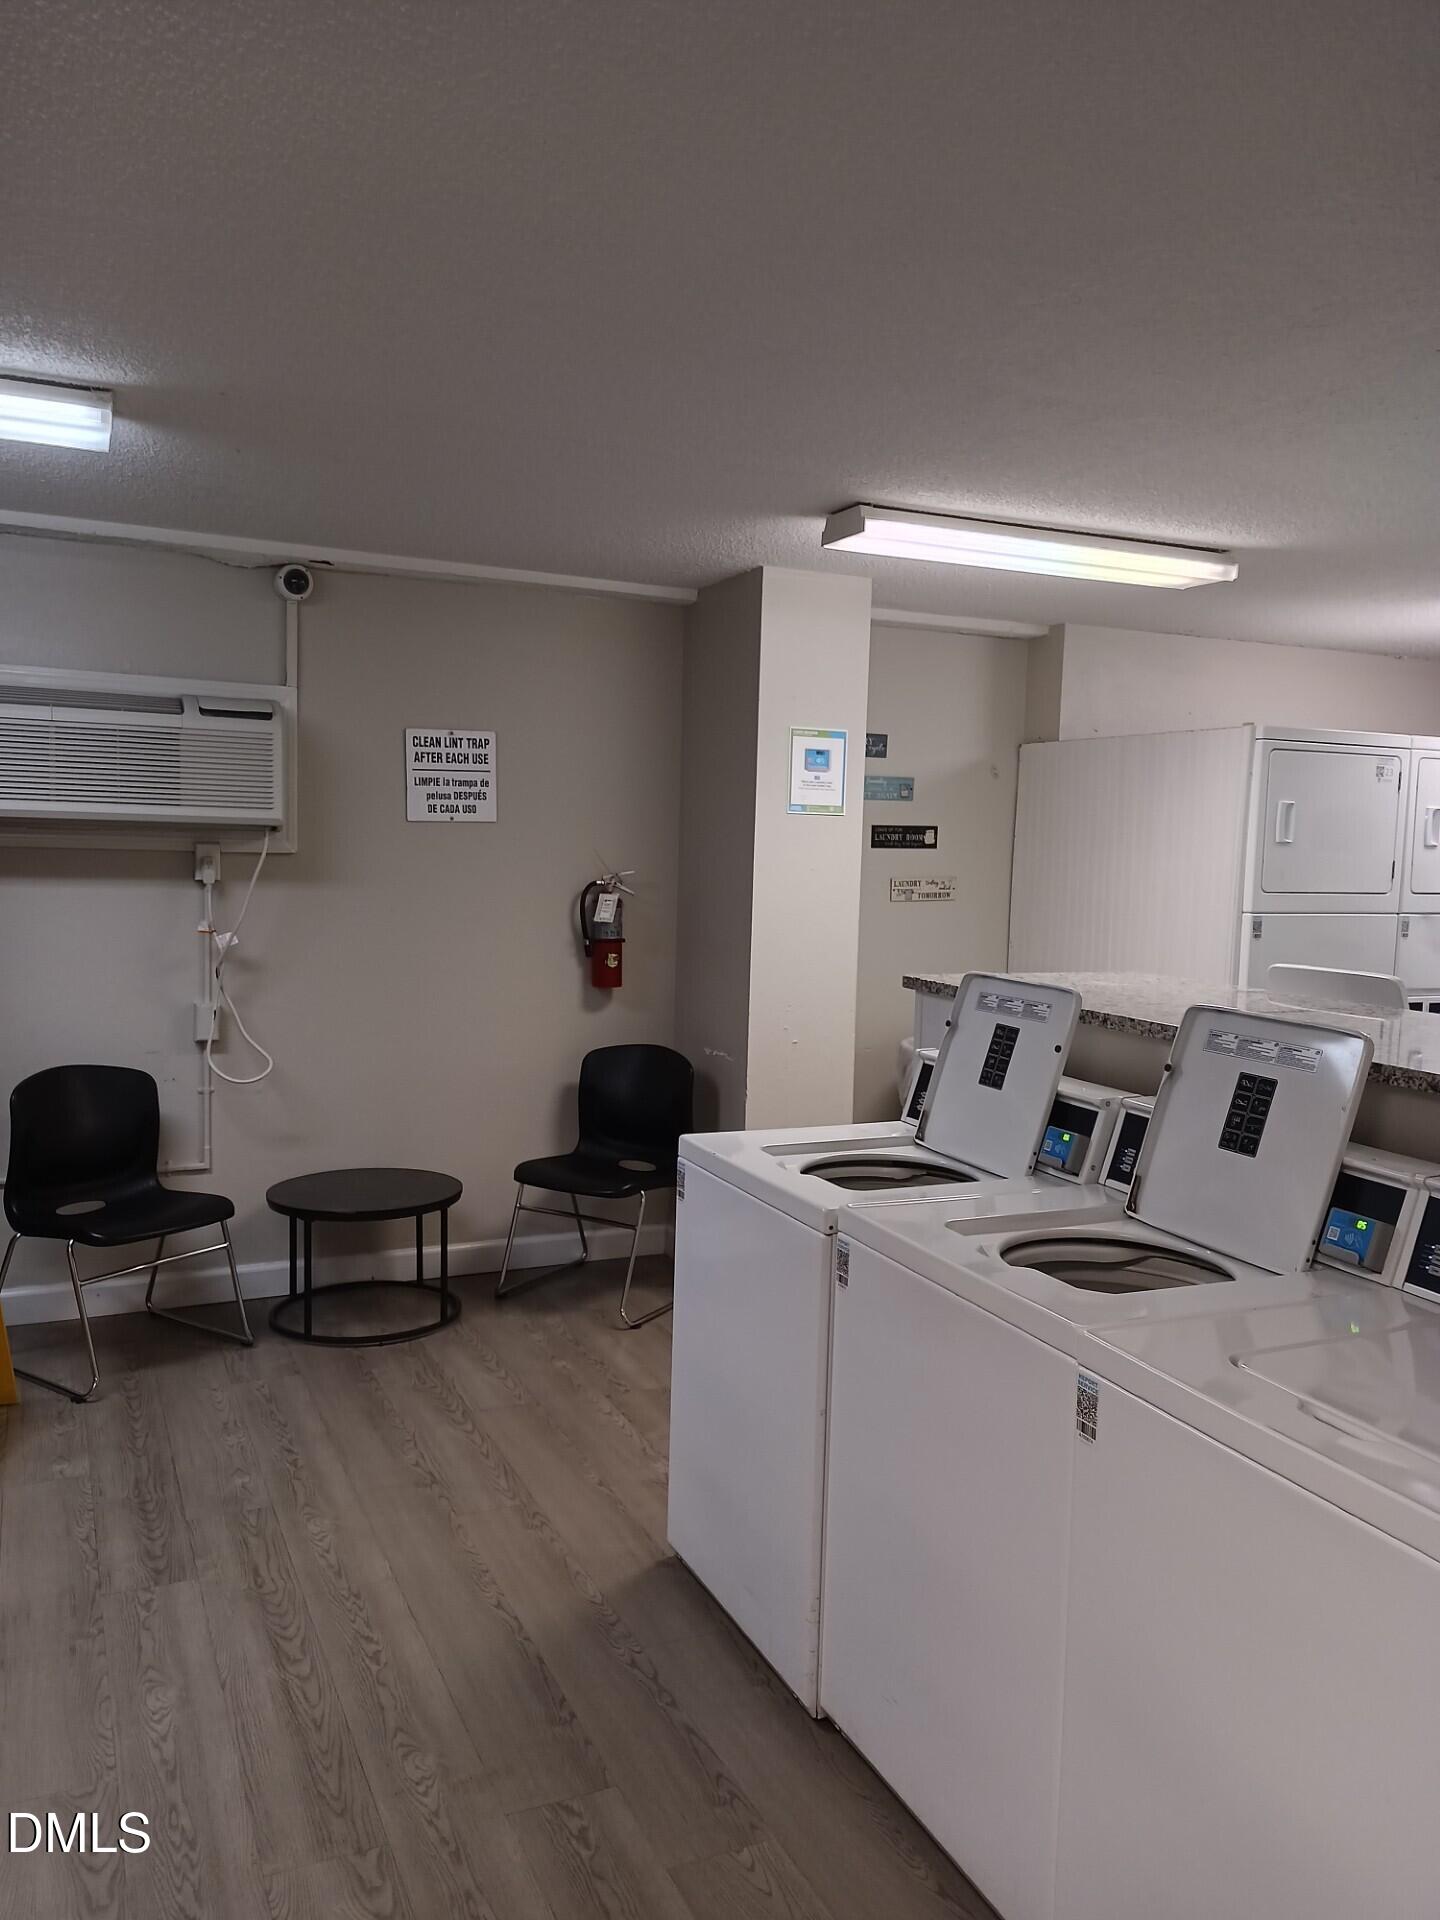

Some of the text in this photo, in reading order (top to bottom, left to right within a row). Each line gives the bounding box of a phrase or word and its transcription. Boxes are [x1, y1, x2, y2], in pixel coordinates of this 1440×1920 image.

[412, 736, 490, 749] CLEAN LINT TRAP
[413, 752, 489, 765] AFTER EACH USE
[413, 777, 490, 789] LIMPIE la trampa de
[426, 790, 487, 802] pelusa DESPUÉS
[427, 804, 477, 814] DE CADA USO
[874, 833, 903, 841] LAUNDRY
[893, 880, 921, 888] LAUNDRY
[917, 892, 951, 900] TOMORROW
